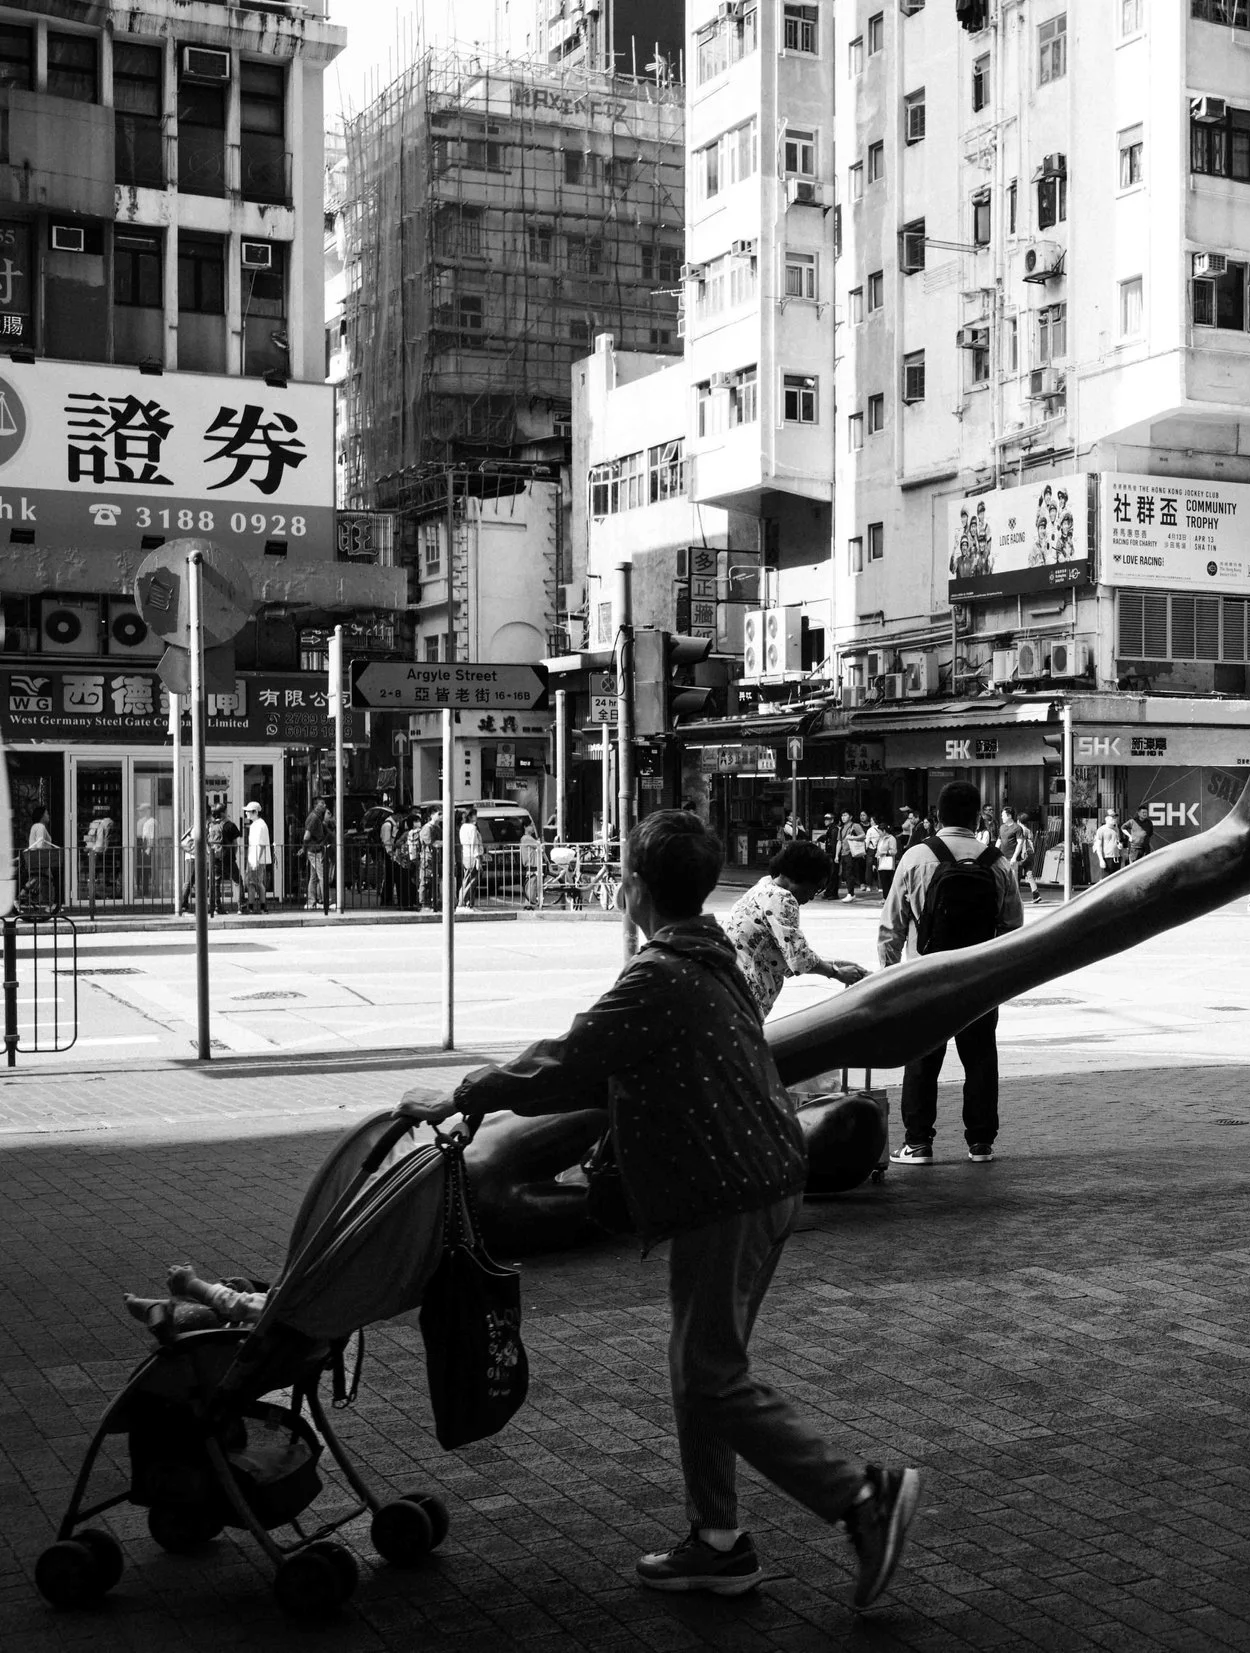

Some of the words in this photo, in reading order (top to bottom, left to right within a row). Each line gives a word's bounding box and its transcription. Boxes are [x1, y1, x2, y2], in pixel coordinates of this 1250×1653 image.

[64, 393, 307, 495] 證券
[1113, 493, 1178, 526] 社群盃
[1186, 499, 1237, 515] COMMUNITY
[136, 506, 215, 532] 3188
[230, 512, 307, 537] 0928
[1186, 515, 1219, 530] TROPHY
[1122, 554, 1138, 565] LOVE
[1139, 555, 1162, 567] RACING
[406, 668, 450, 682] Argyle
[455, 669, 498, 682] Street
[414, 687, 490, 703] 亞皆老街
[595, 698, 607, 707] 24
[9, 715, 37, 725] West
[40, 715, 91, 727] Germany
[95, 716, 122, 726] Steel
[125, 717, 151, 727] Gate
[208, 717, 249, 728] Limited
[320, 725, 353, 738] 199
[945, 739, 971, 760] SHK
[1078, 736, 1121, 756] SHK
[1148, 802, 1200, 826] SHK
